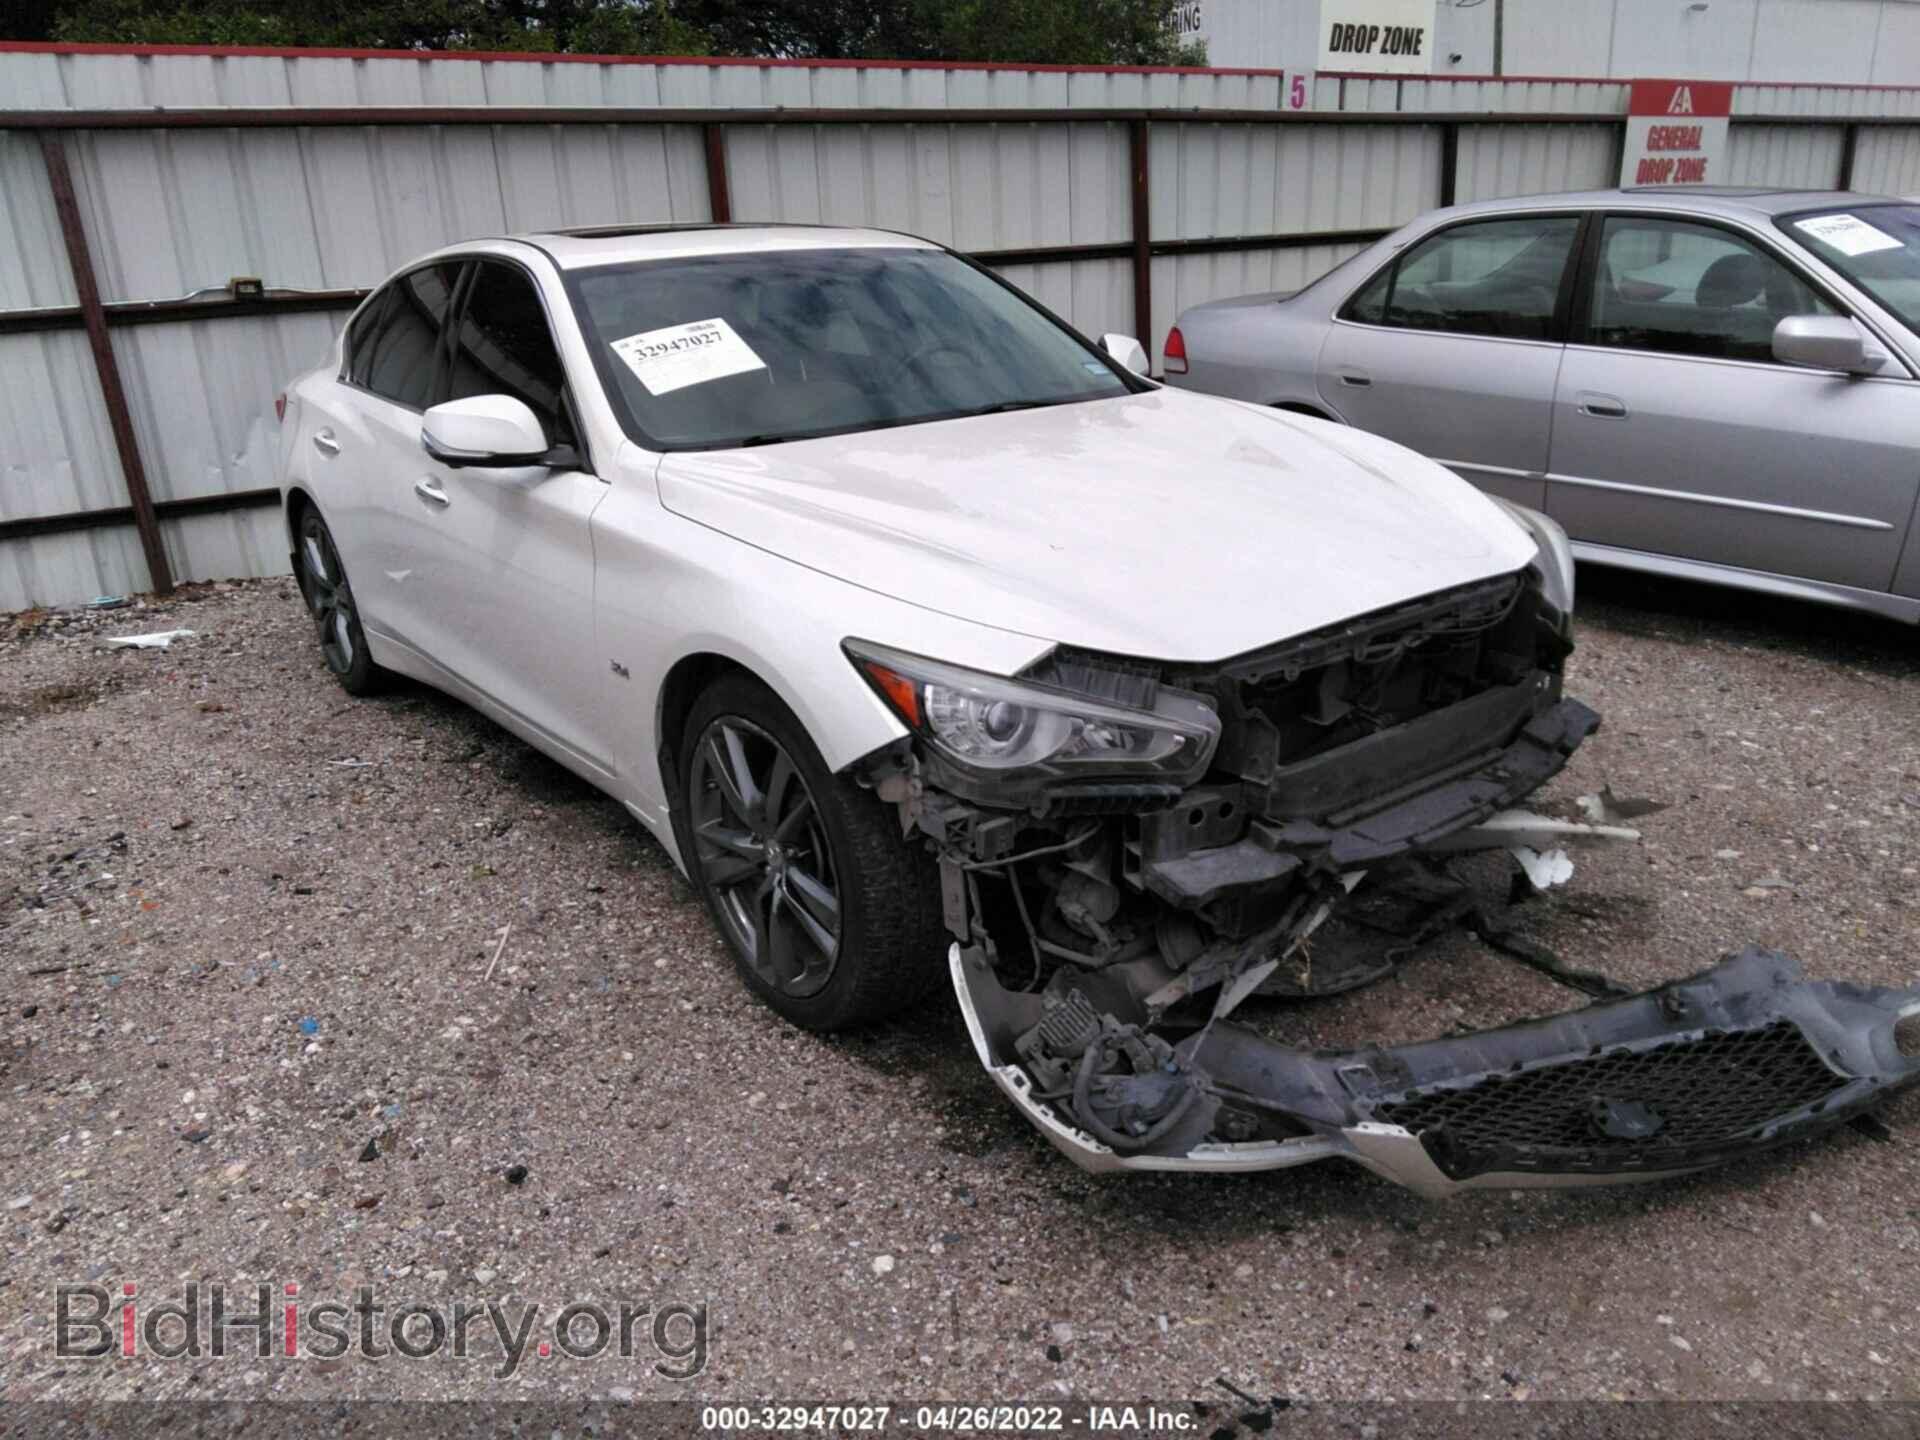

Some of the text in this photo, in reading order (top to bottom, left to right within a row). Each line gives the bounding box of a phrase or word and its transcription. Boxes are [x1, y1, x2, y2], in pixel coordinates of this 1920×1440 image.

[1329, 22, 1424, 55] DROP ZONE
[1291, 75, 1305, 109] 5
[1647, 126, 1703, 151] GENERAL
[1635, 157, 1708, 184] DROP ZONE
[634, 330, 722, 361] 32947027
